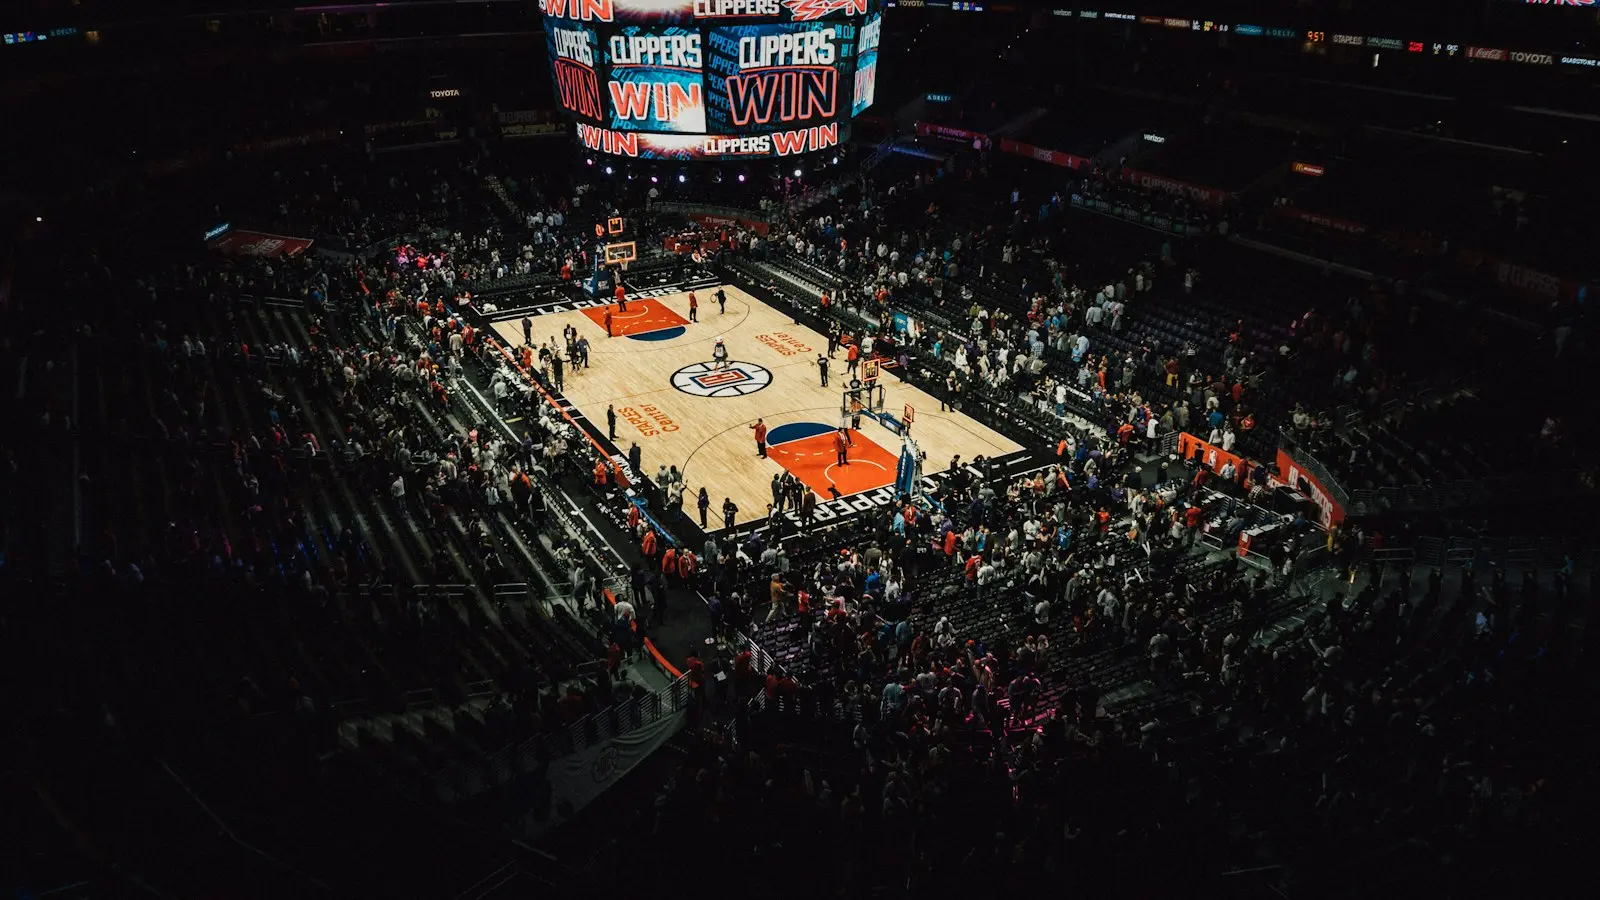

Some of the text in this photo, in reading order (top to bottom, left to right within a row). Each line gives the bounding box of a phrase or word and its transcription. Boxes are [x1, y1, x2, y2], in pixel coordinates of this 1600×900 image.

[693, 0, 780, 17] CLIPPERS
[898, 0, 925, 8] TOYOTA
[1164, 18, 1191, 28] TOSHIBA
[1272, 28, 1297, 38] DELTA
[553, 27, 594, 68] CLIPPERS
[610, 33, 703, 69] CLIPPERS
[738, 27, 836, 70] CLIPPERS
[1333, 34, 1364, 46] STAPLES
[1510, 51, 1553, 65] TOYOTA
[430, 89, 460, 98] TOYOTA
[554, 59, 603, 121] WIN
[608, 80, 703, 122] WIN
[724, 68, 839, 126] WIN
[932, 94, 952, 102] DELTA
[582, 123, 638, 157] WIN
[704, 134, 771, 154] CLIPPERS
[772, 122, 838, 156] WIN
[1142, 132, 1165, 144] verizon
[537, 286, 683, 315] LA CLIPERS
[754, 333, 797, 357] STAPLES
[772, 330, 813, 353] Center
[618, 406, 660, 438] STAPLES
[639, 403, 680, 433] Center
